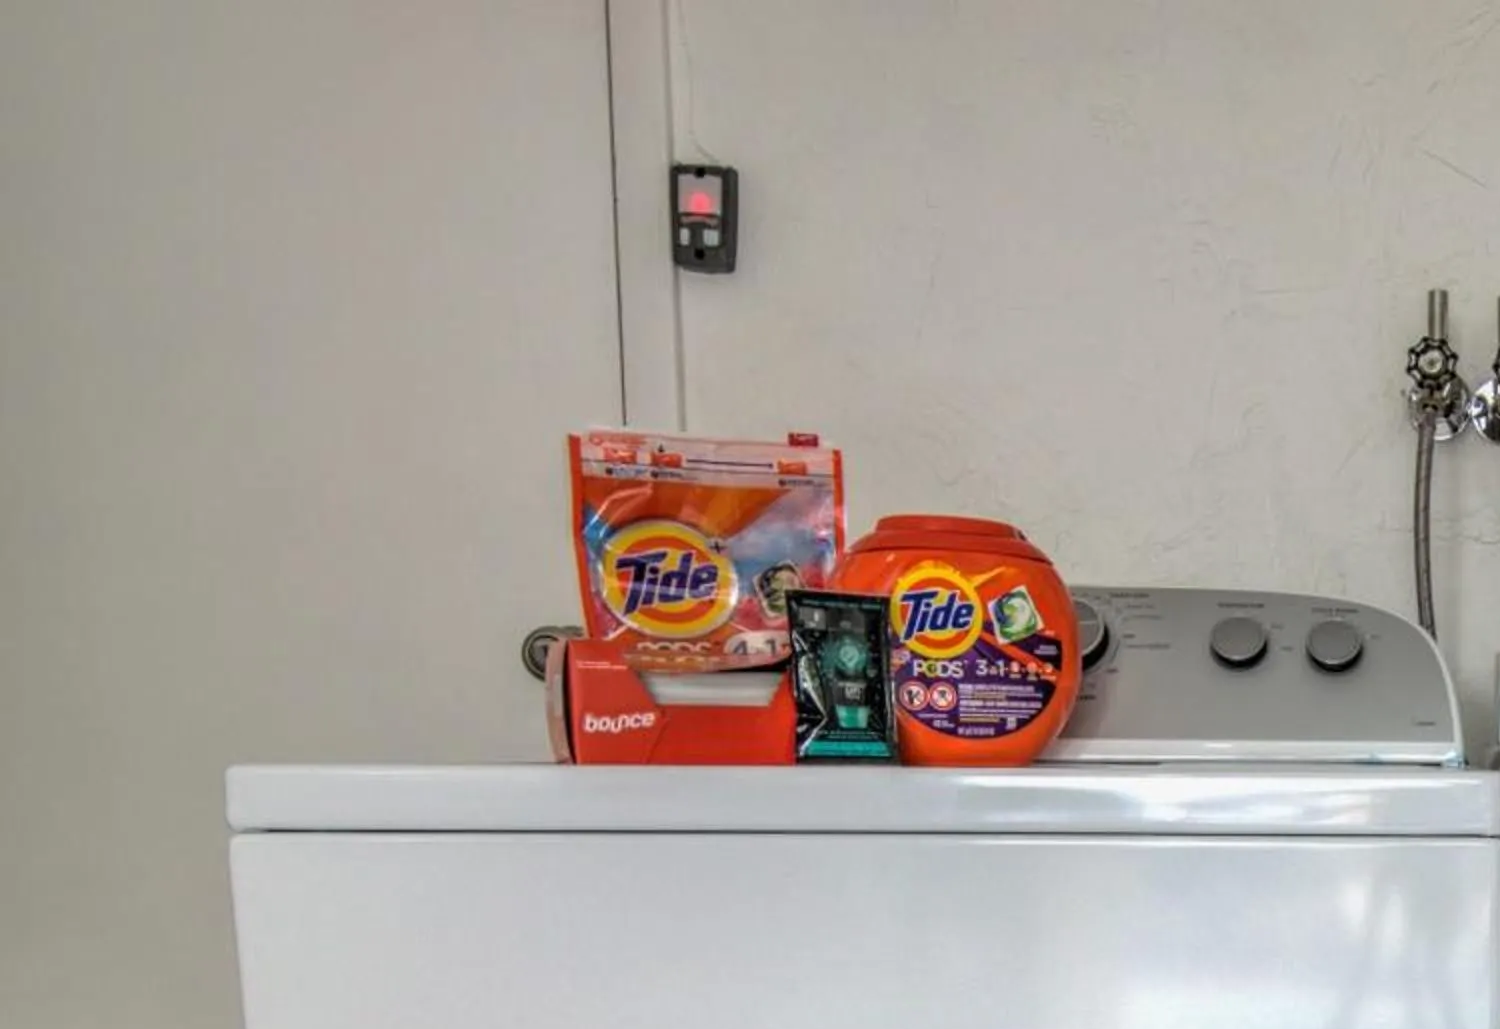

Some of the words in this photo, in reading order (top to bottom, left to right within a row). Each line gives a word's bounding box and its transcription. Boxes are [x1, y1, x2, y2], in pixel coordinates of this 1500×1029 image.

[615, 549, 719, 616] Tide
[900, 590, 975, 641] Tide
[912, 659, 964, 678] PODS
[583, 712, 656, 734] bounce
